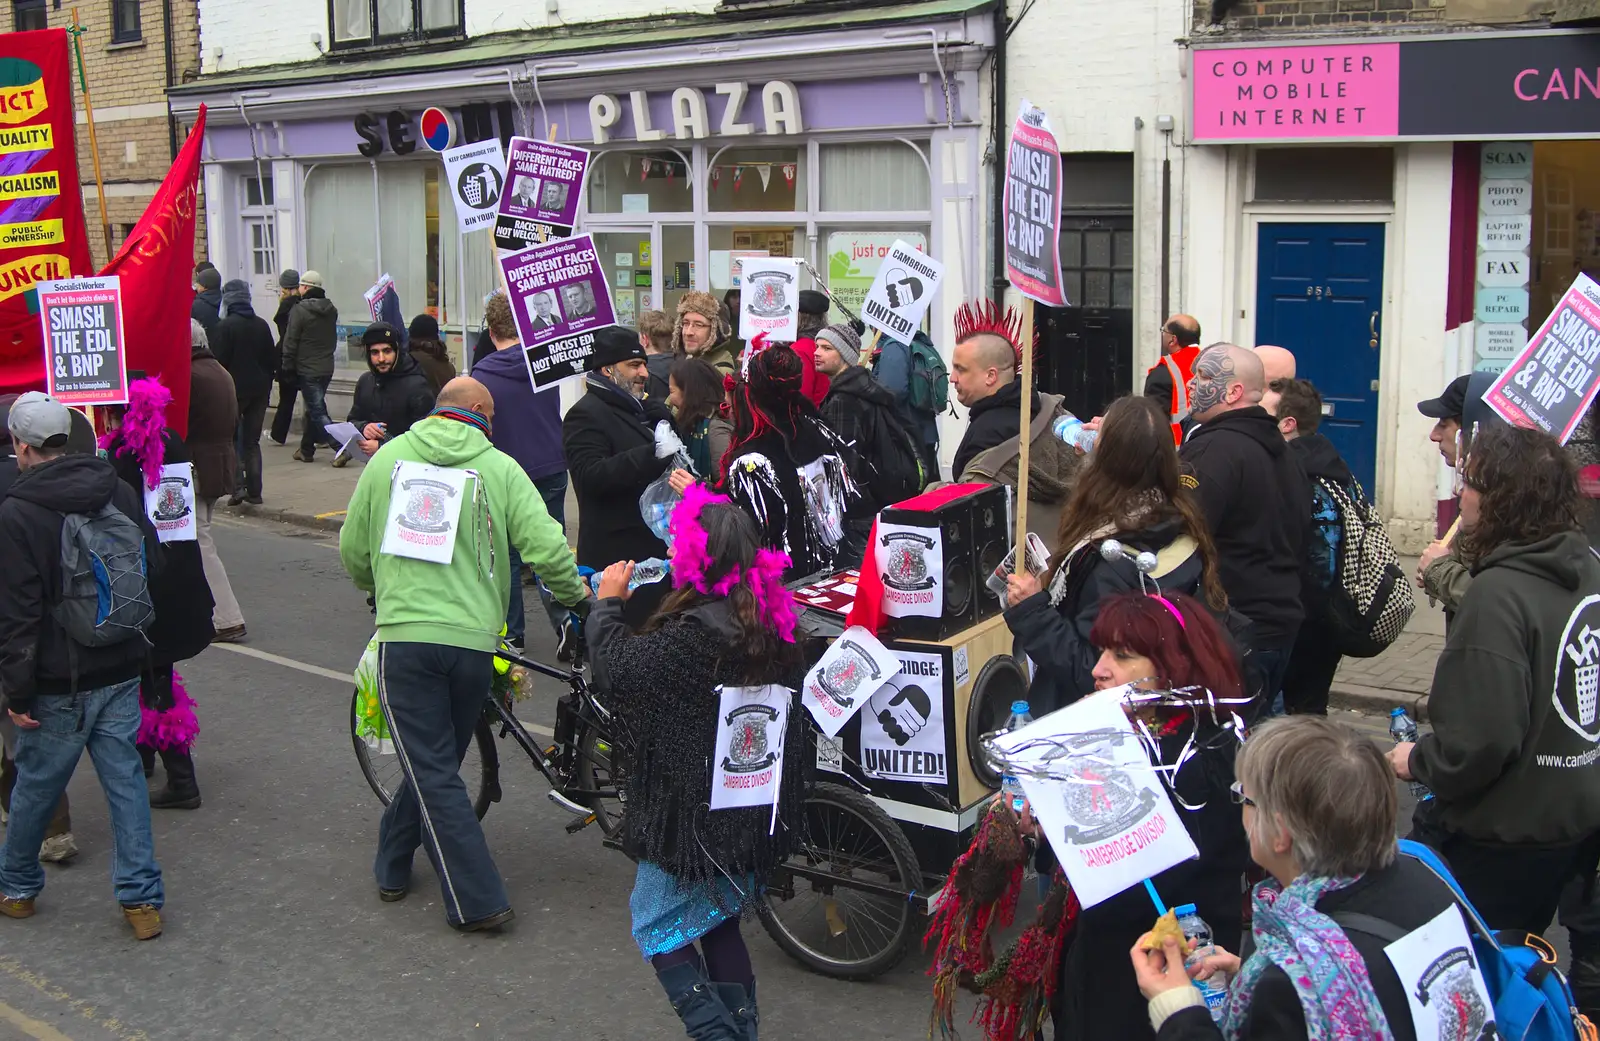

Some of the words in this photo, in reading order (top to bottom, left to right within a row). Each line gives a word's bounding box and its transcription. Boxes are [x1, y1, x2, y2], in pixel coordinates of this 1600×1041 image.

[1212, 56, 1373, 77] COMPUTER
[1238, 82, 1347, 100] MOBILE
[1514, 67, 1600, 101] CAN
[588, 80, 803, 145] PLAZA
[1220, 108, 1366, 126] INTERNET
[460, 150, 486, 160] CAMBRIDGE
[513, 150, 557, 166] DIFFERENT
[558, 158, 583, 172] FACES
[1485, 152, 1527, 165] SCAN
[514, 160, 538, 174] SAME
[540, 165, 577, 181] HATRED!
[1010, 141, 1050, 190] SMASH
[0, 176, 57, 193] CIALISM
[1488, 186, 1524, 196] PHOTO
[1008, 177, 1027, 217] THE
[1030, 188, 1054, 230] EDL
[1492, 198, 1519, 206] COPY
[464, 216, 478, 226] BIN
[478, 212, 495, 223] YOUR
[1486, 222, 1524, 230] LAPTOP
[3, 232, 55, 243] OWNERSHIP
[12, 226, 43, 234] PUBLIC
[496, 226, 513, 238] NOT
[1008, 212, 1016, 248] &
[1018, 219, 1044, 258] BNP
[1486, 233, 1522, 242] REPAIR
[520, 254, 535, 262] Unite
[535, 249, 556, 260] Against
[555, 244, 576, 254] Fascism
[852, 240, 874, 260] just
[508, 256, 564, 283] DIFFERENT
[564, 248, 596, 266] FACES
[892, 249, 938, 282] CAMBRIDGE:
[1486, 261, 1520, 274] FAX
[516, 276, 546, 293] SAME
[548, 262, 594, 284] HATRED!
[1496, 294, 1509, 302] PC
[50, 305, 106, 330] SMASH
[866, 300, 914, 336] UNITED!
[1485, 305, 1520, 314] REPAIR
[52, 330, 81, 354] THE
[86, 328, 116, 352] EDL
[548, 338, 578, 354] RACIST
[1552, 308, 1600, 365] SMASH
[55, 356, 68, 378] &
[70, 354, 104, 376] BNP
[532, 356, 550, 373] NOT
[550, 345, 594, 365] WELCOME
[1534, 333, 1570, 374] THE
[1558, 356, 1594, 398] EDL
[56, 382, 66, 392] Say
[80, 381, 110, 390] Islamophobia
[1514, 360, 1538, 389] &
[1530, 372, 1566, 410] BNP
[914, 592, 934, 604] DIVISION
[865, 748, 944, 776] UNITED!
[724, 774, 750, 789] CAMBRIDGE
[752, 769, 773, 788] DIVISION
[1080, 834, 1138, 868] CAMBRIDGE
[1132, 812, 1168, 850] DIVISION
